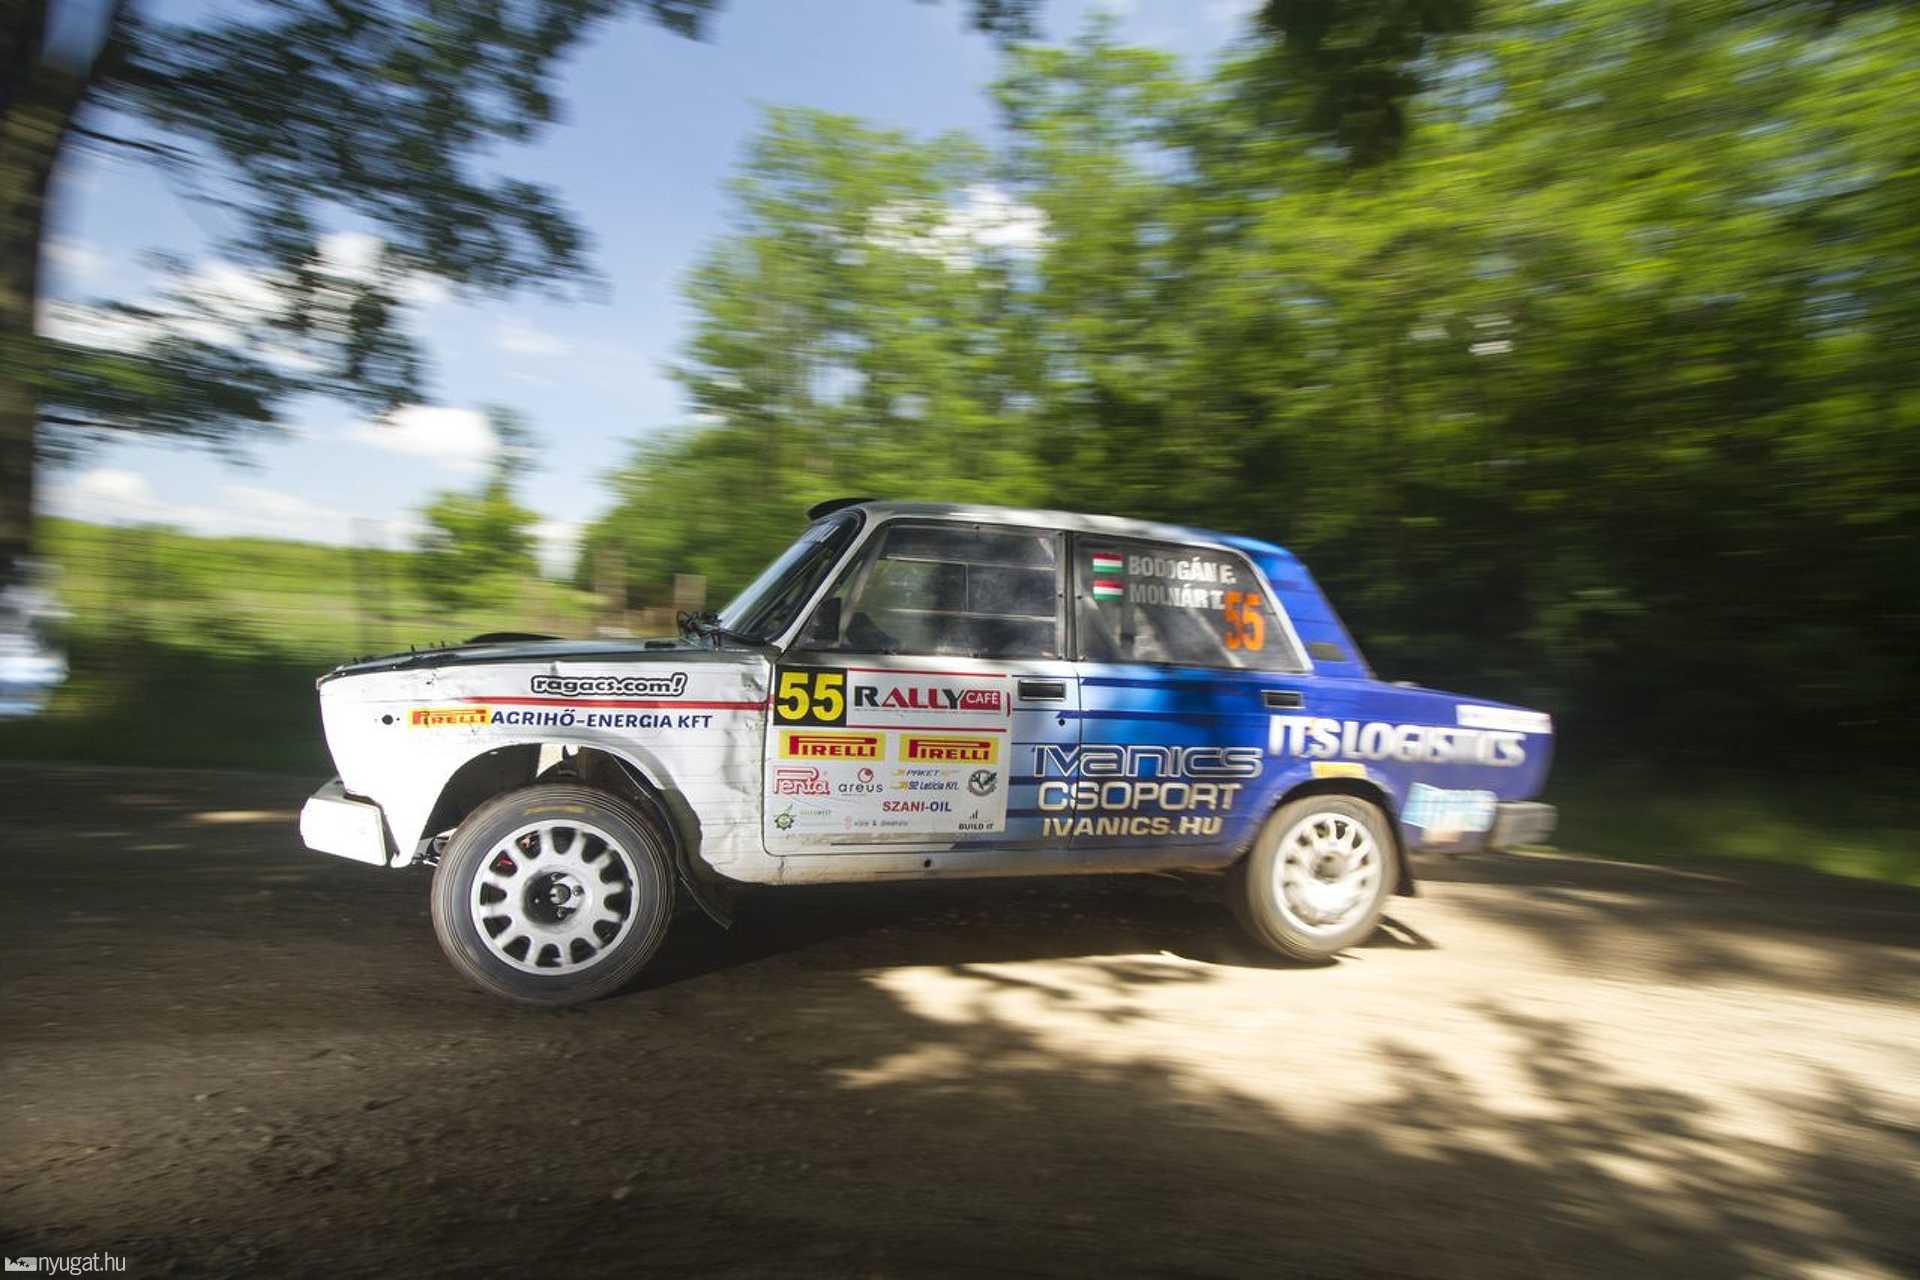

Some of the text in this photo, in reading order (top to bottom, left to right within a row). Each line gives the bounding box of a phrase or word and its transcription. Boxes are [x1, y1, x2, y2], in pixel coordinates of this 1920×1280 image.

[1129, 584, 1207, 609] MOLNÁR
[1224, 591, 1265, 651] 55
[533, 674, 686, 695] ragacs.com!
[776, 671, 845, 721] 55
[855, 686, 965, 709] RALLY
[412, 709, 487, 725] PIRELLI
[491, 709, 713, 728] AGRIHŐ-ENERGIA KFT
[789, 735, 878, 757] PIRELLI
[909, 739, 991, 760] PIRELLI
[773, 767, 831, 795] Penta
[838, 783, 884, 793] areus
[882, 801, 953, 812] SZANI-OIL
[1038, 781, 1243, 811] CSOPORT
[958, 823, 984, 831] BUILD
[1042, 816, 1224, 837] IVANICS.HU
